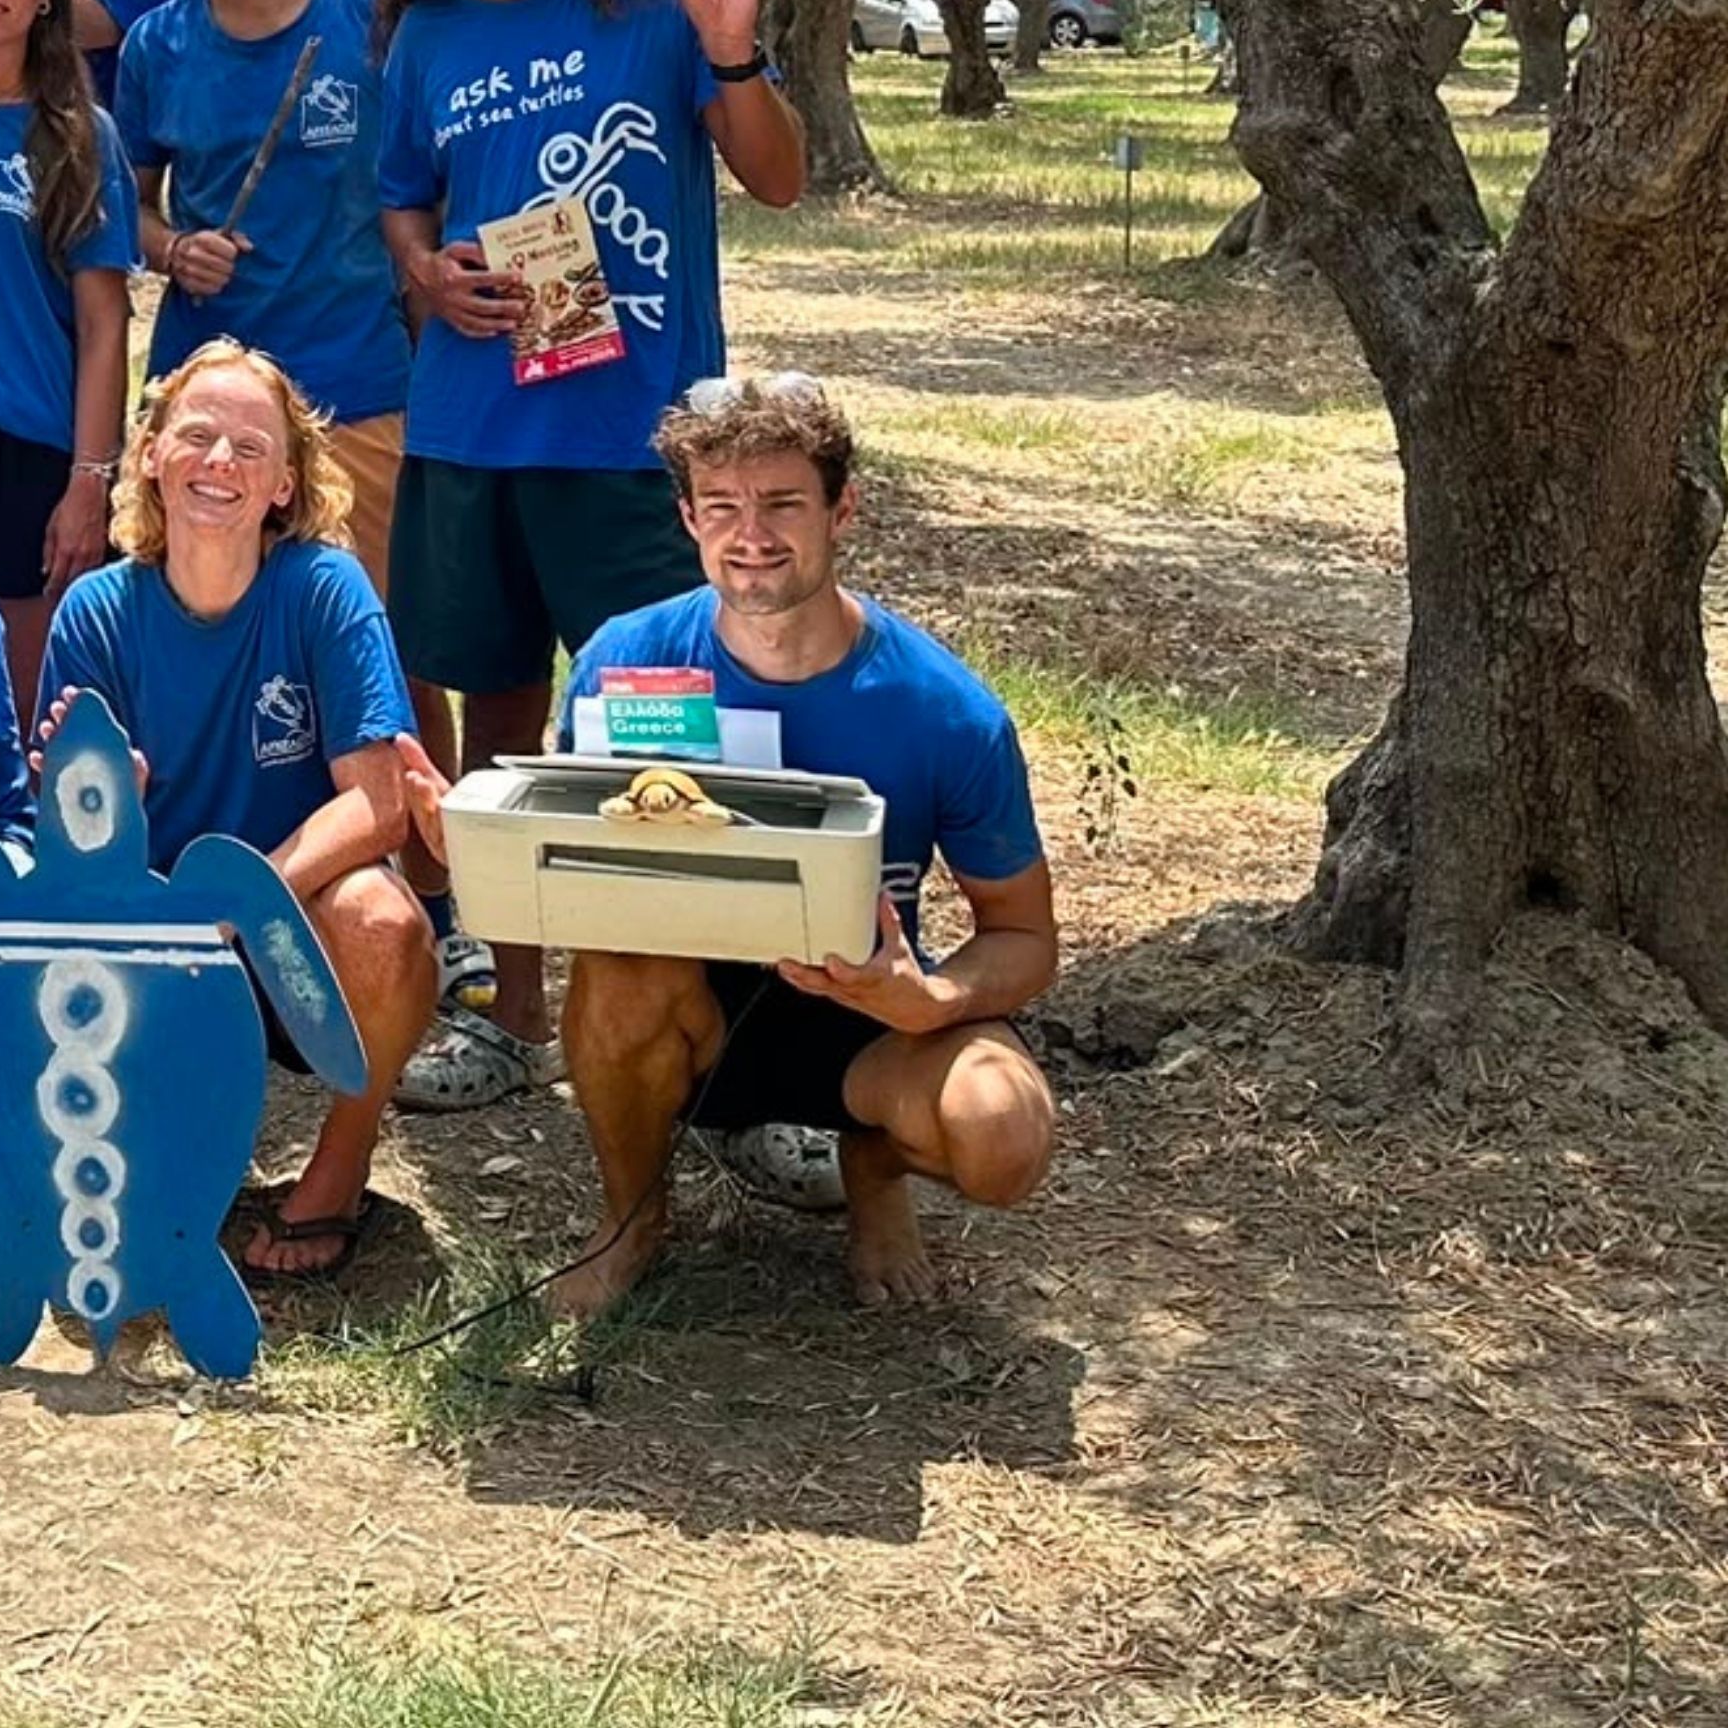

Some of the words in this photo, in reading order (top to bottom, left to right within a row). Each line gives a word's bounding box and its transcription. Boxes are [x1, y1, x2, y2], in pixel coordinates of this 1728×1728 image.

[450, 66, 514, 112] ask
[530, 49, 585, 88] me
[479, 107, 514, 127] sea
[518, 83, 584, 114] turtles
[612, 718, 686, 734] Greece
